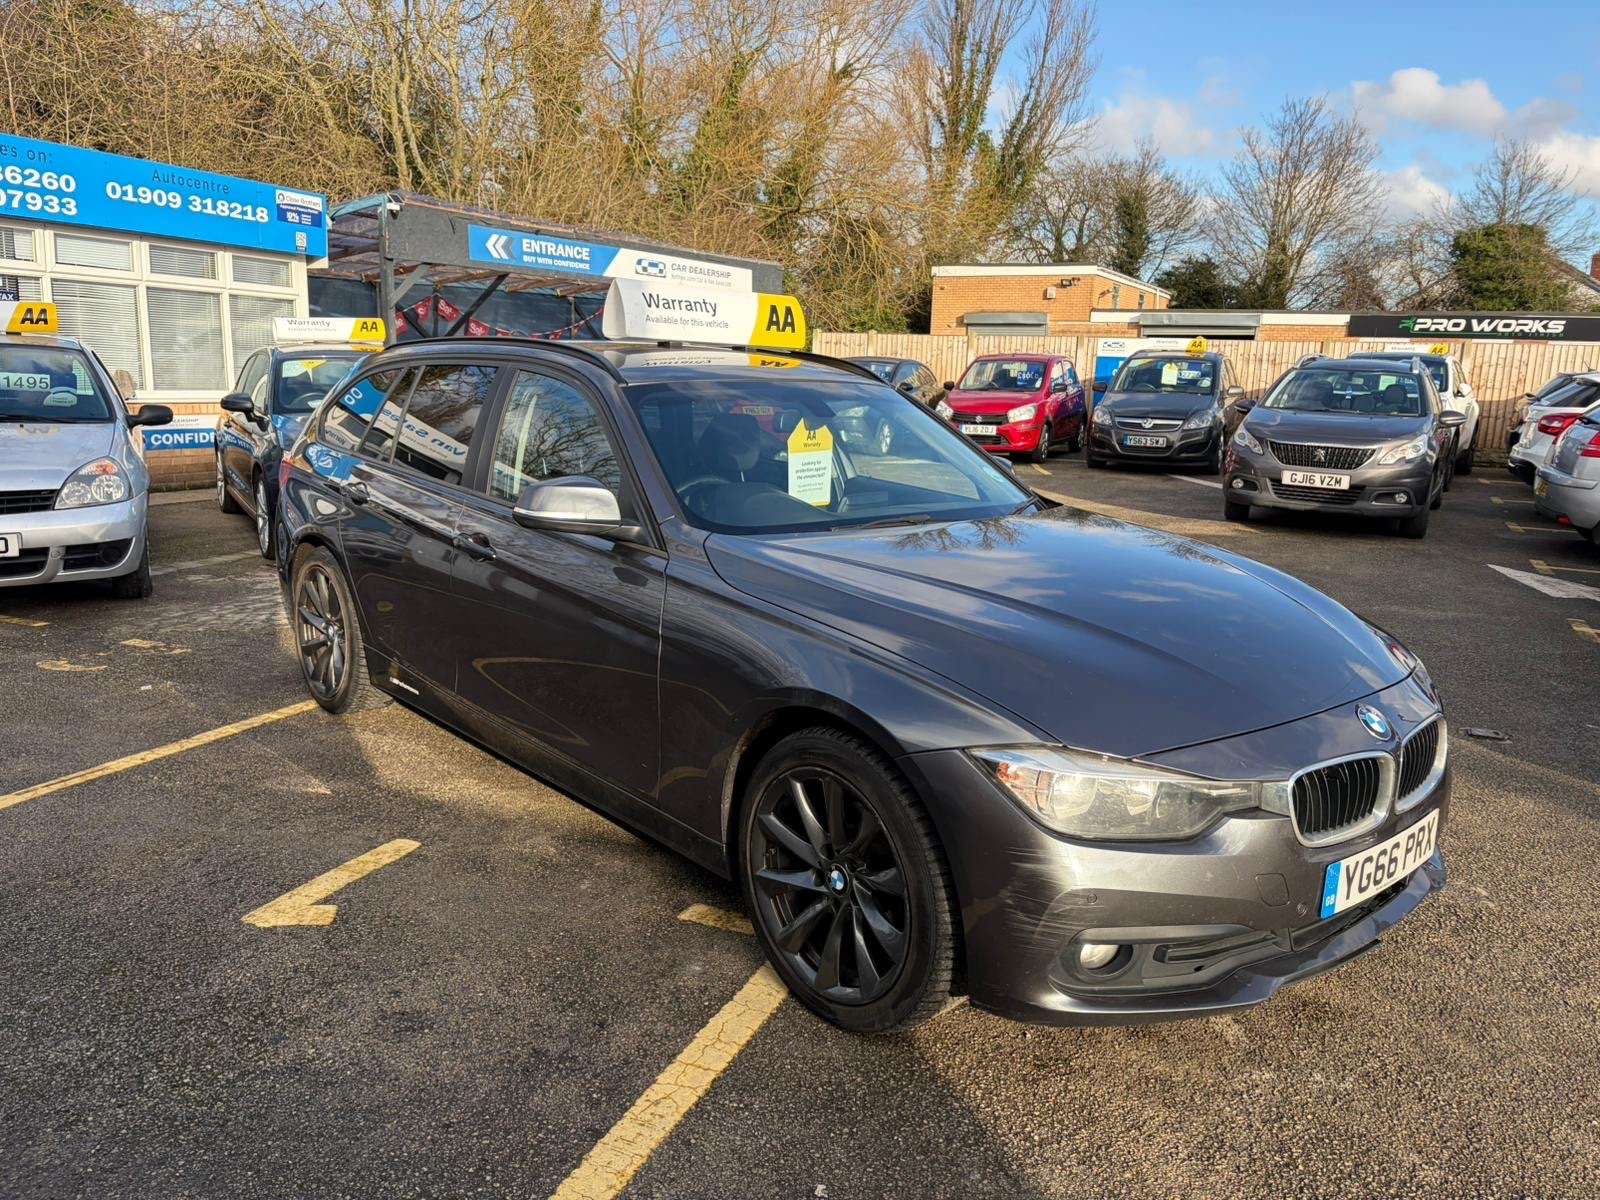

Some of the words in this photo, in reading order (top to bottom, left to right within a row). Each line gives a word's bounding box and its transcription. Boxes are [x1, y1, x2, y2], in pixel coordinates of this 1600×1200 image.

[0, 165, 76, 193] 6260
[152, 169, 230, 194] Autocentre
[105, 181, 182, 209] 01909
[188, 195, 269, 223] 318218
[522, 238, 591, 260] ENTRANCE
[523, 255, 536, 263] BUY
[537, 256, 553, 265] WITH
[553, 258, 590, 270] CONFIDENCE
[671, 263, 687, 273] CAR
[688, 265, 732, 279] DEALERSHIP
[0, 293, 14, 301] AX
[641, 292, 718, 317] Warranty
[20, 307, 49, 325] AA
[645, 315, 678, 325] Available
[680, 317, 690, 325] for
[690, 317, 704, 326] this
[704, 319, 729, 329] vehicle
[766, 304, 796, 333] AA
[360, 321, 379, 333] AA
[1413, 318, 1467, 332] PRO
[1471, 318, 1567, 334] WORKS
[3, 375, 49, 390] 1495
[806, 430, 817, 441] AA
[1290, 472, 1316, 485] GJ16
[1320, 475, 1342, 487] VZM
[1345, 841, 1401, 901] YG66
[1402, 816, 1436, 871] PRX
